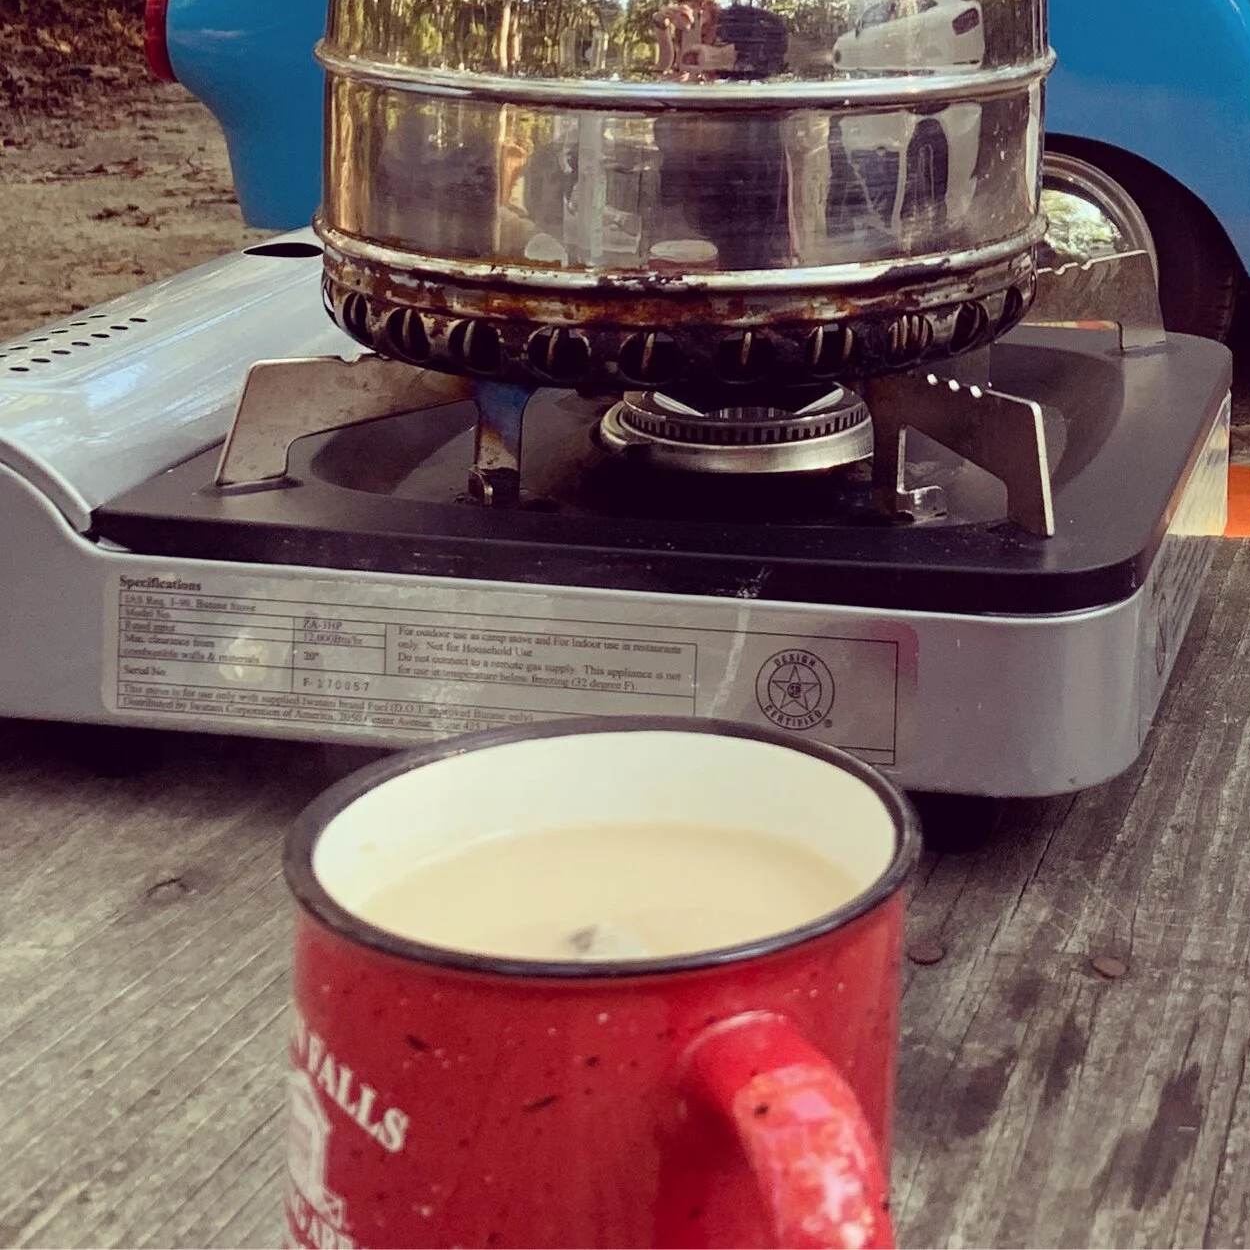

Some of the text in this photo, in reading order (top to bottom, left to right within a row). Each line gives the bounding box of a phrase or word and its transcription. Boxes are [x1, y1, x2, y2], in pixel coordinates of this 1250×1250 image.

[120, 575, 202, 591] Specifications
[773, 653, 816, 667] DESIGN
[765, 705, 822, 727] CERTIFIED
